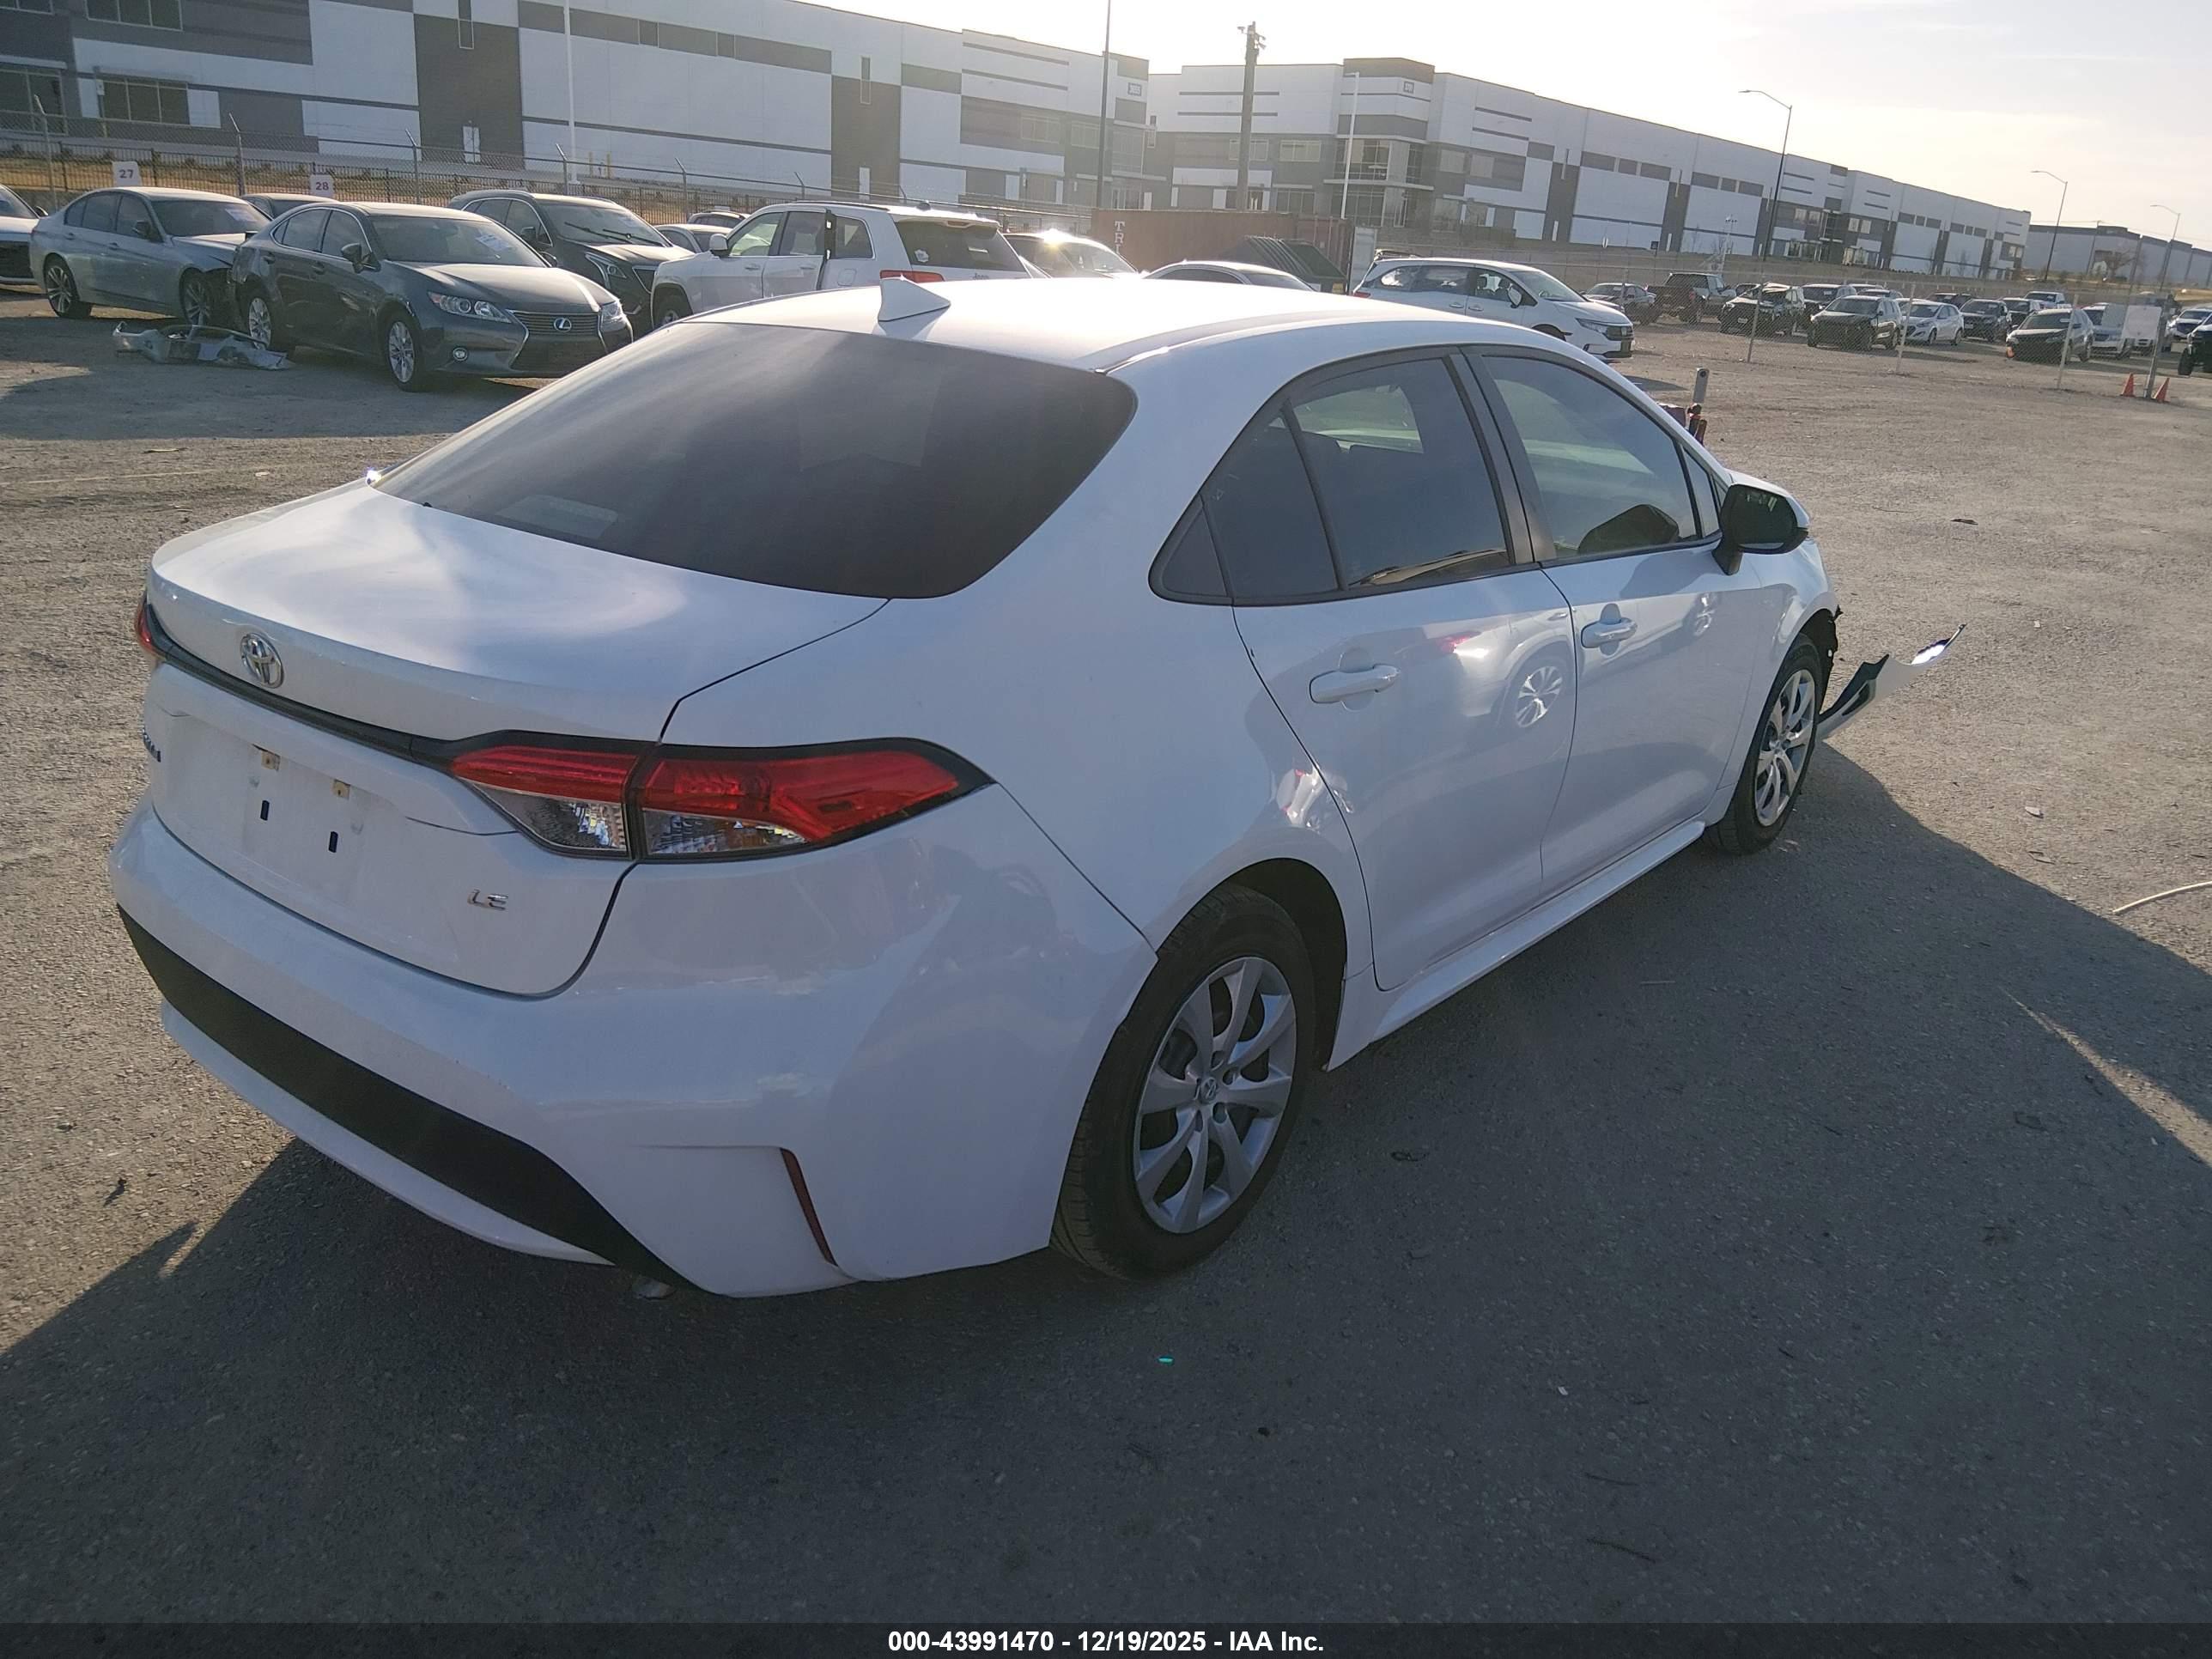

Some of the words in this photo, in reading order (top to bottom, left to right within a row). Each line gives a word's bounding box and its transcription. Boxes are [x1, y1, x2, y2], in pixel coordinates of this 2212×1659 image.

[119, 169, 134, 179] 27
[316, 181, 329, 191] 28
[468, 889, 508, 911] LE
